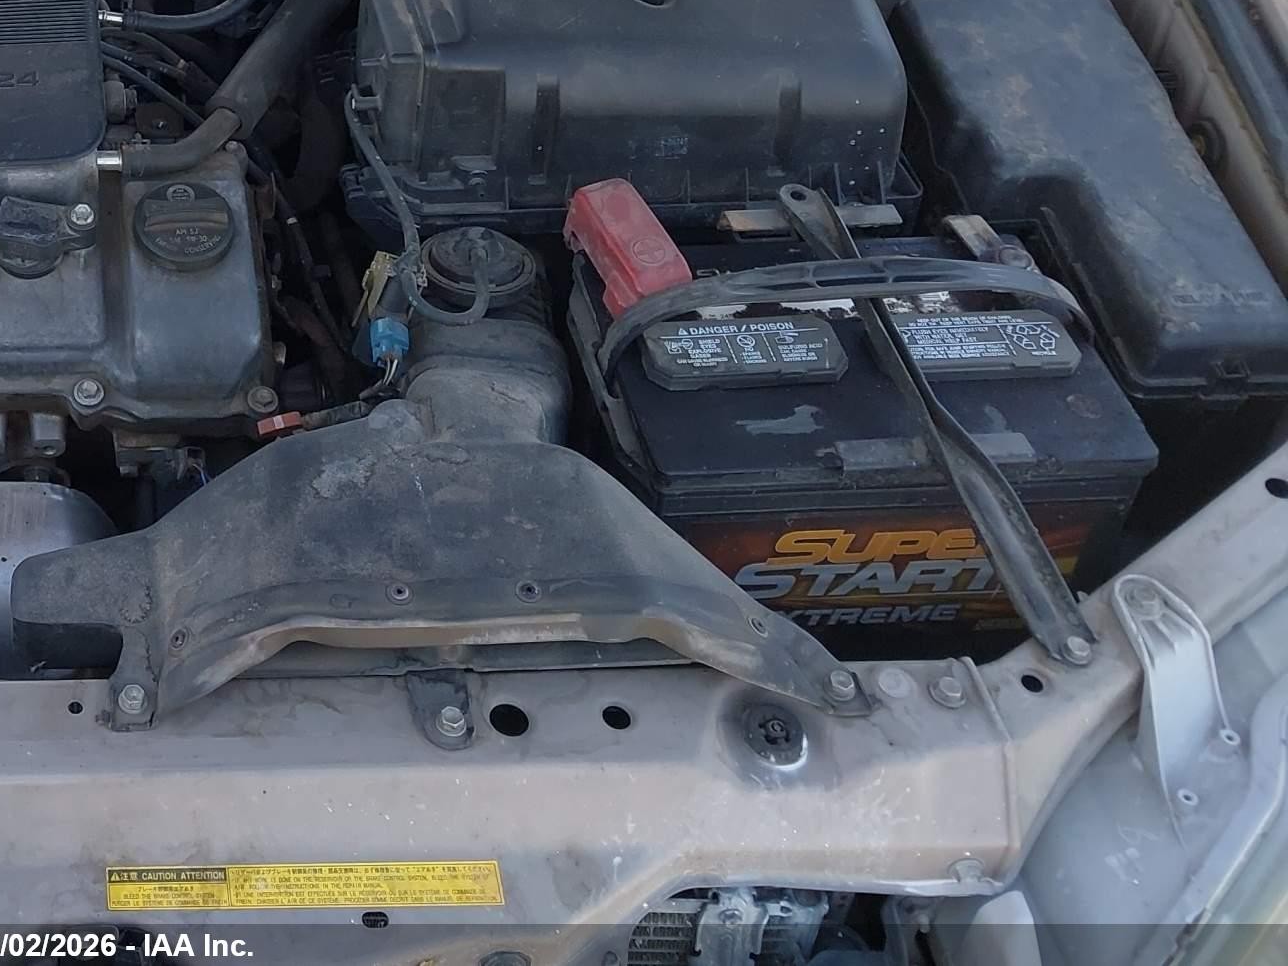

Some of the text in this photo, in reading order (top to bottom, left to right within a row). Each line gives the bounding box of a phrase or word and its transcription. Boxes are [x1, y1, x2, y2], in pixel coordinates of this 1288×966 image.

[689, 322, 795, 335] DANGER / POISON
[767, 529, 987, 565] SUPE
[141, 871, 177, 881] CAUTION
[180, 870, 225, 881] ATTENTION
